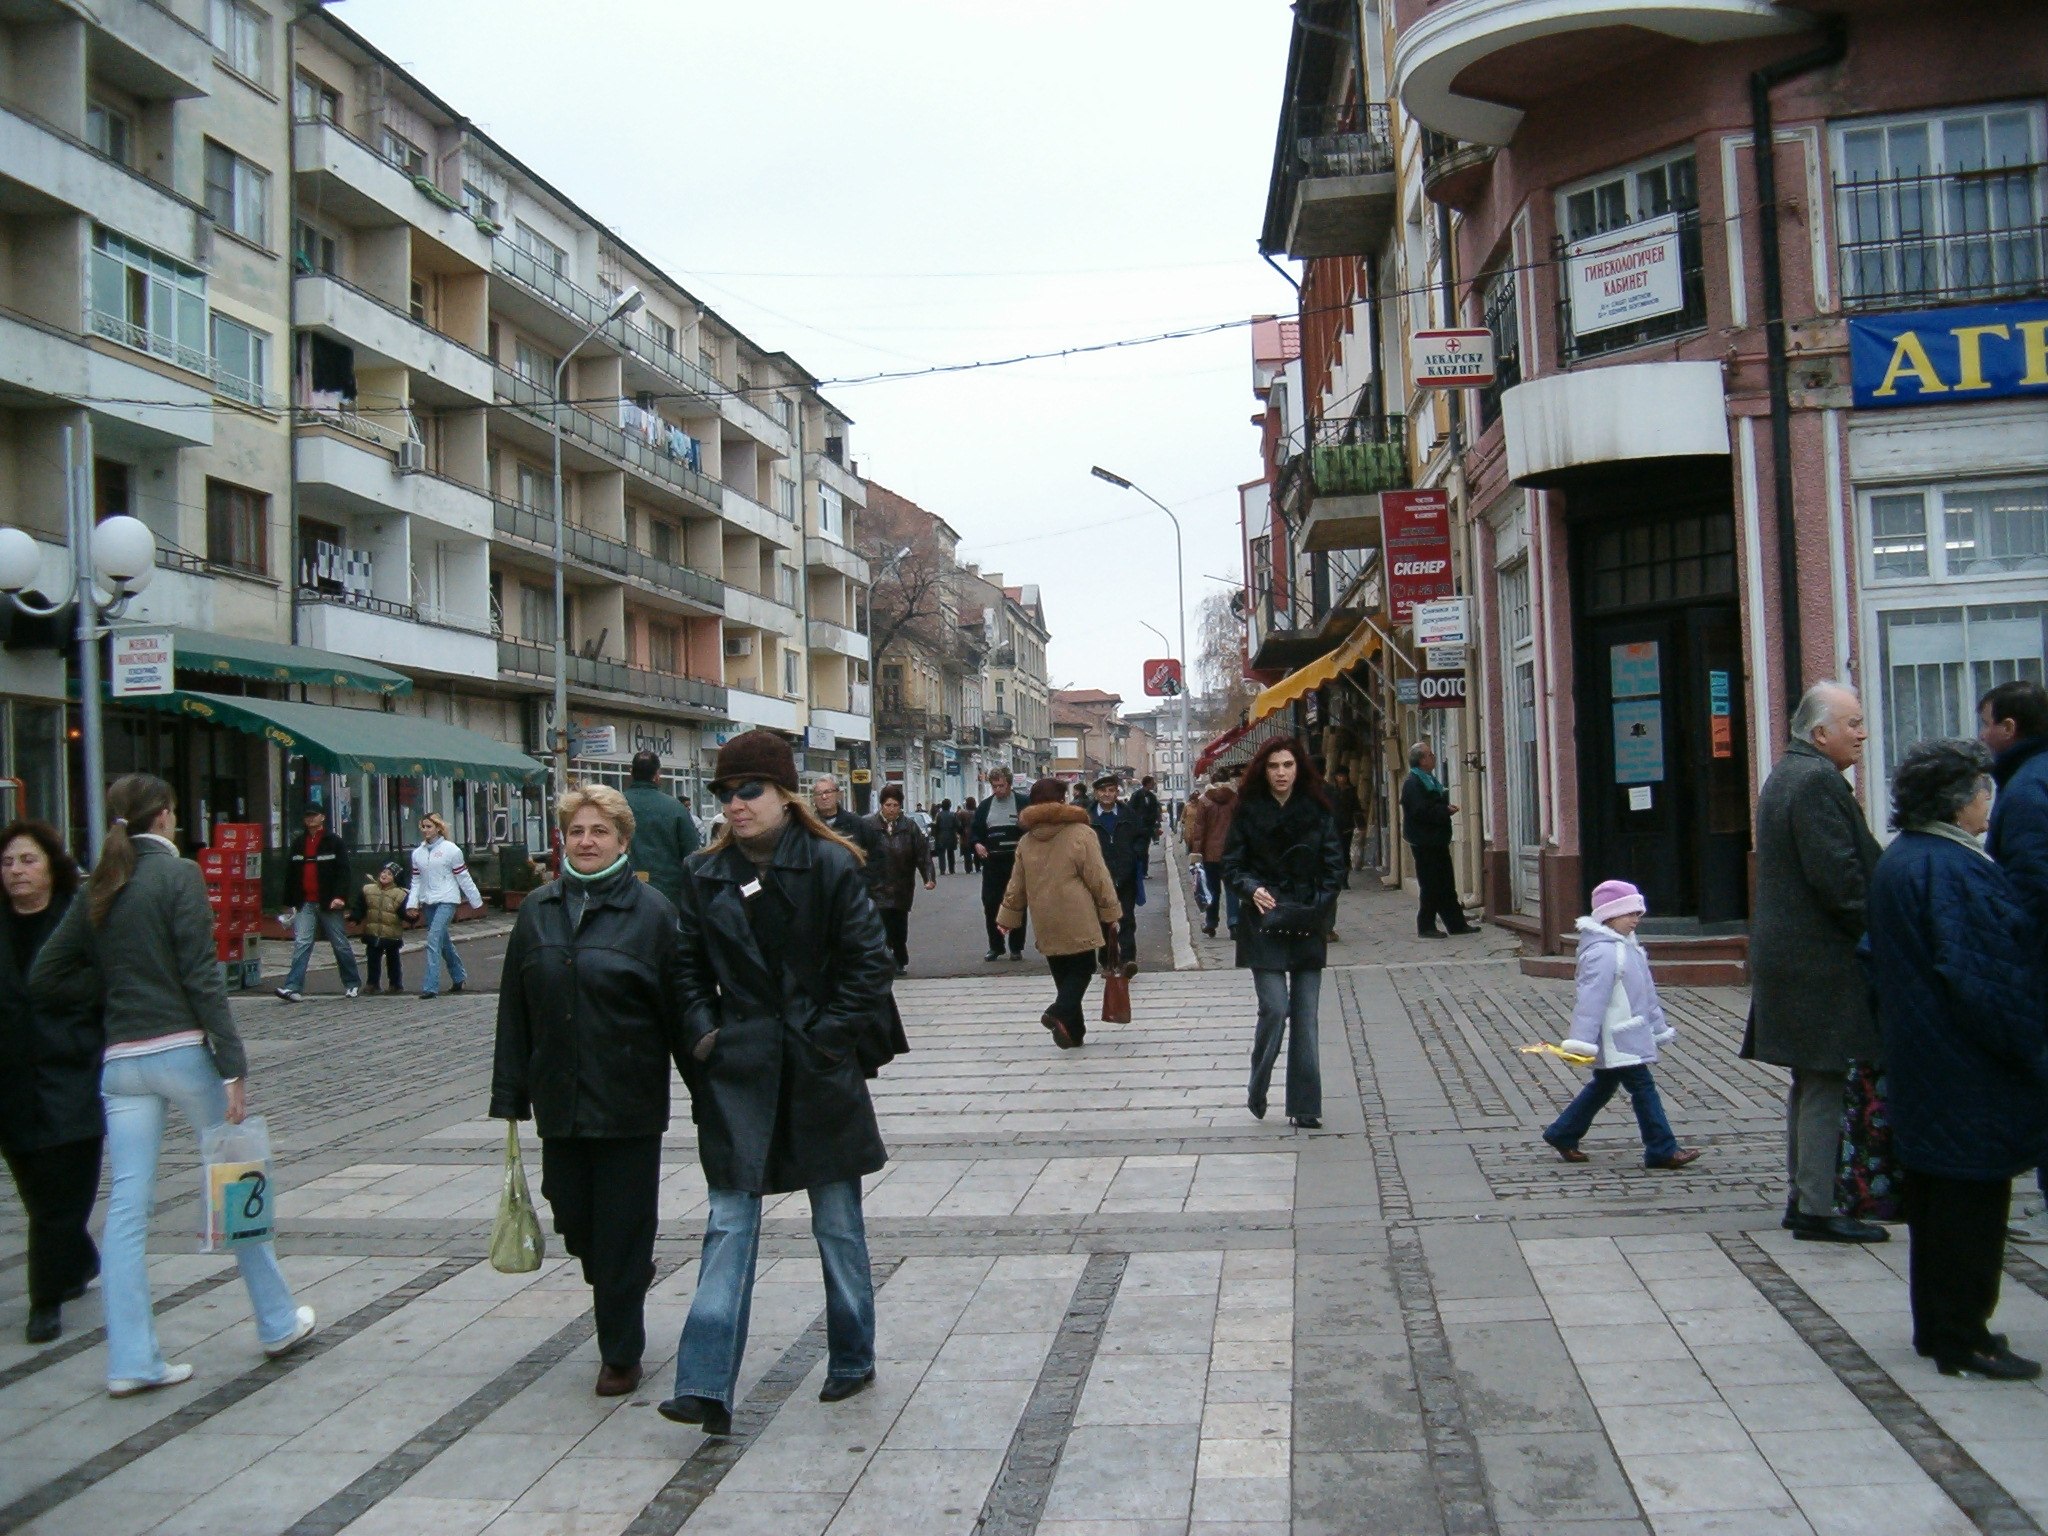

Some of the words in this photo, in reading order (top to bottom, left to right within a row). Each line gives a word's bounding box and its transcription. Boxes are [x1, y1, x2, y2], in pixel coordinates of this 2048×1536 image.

[1584, 245, 1666, 282] ГИНЕКОЛОГИЧЕН
[1603, 270, 1649, 297] КАБИНЕТ
[1424, 352, 1485, 365] ЛЕКАРСКИ
[1427, 364, 1481, 376] КАБИНЕТ
[1393, 560, 1447, 576] СКЕНЕР
